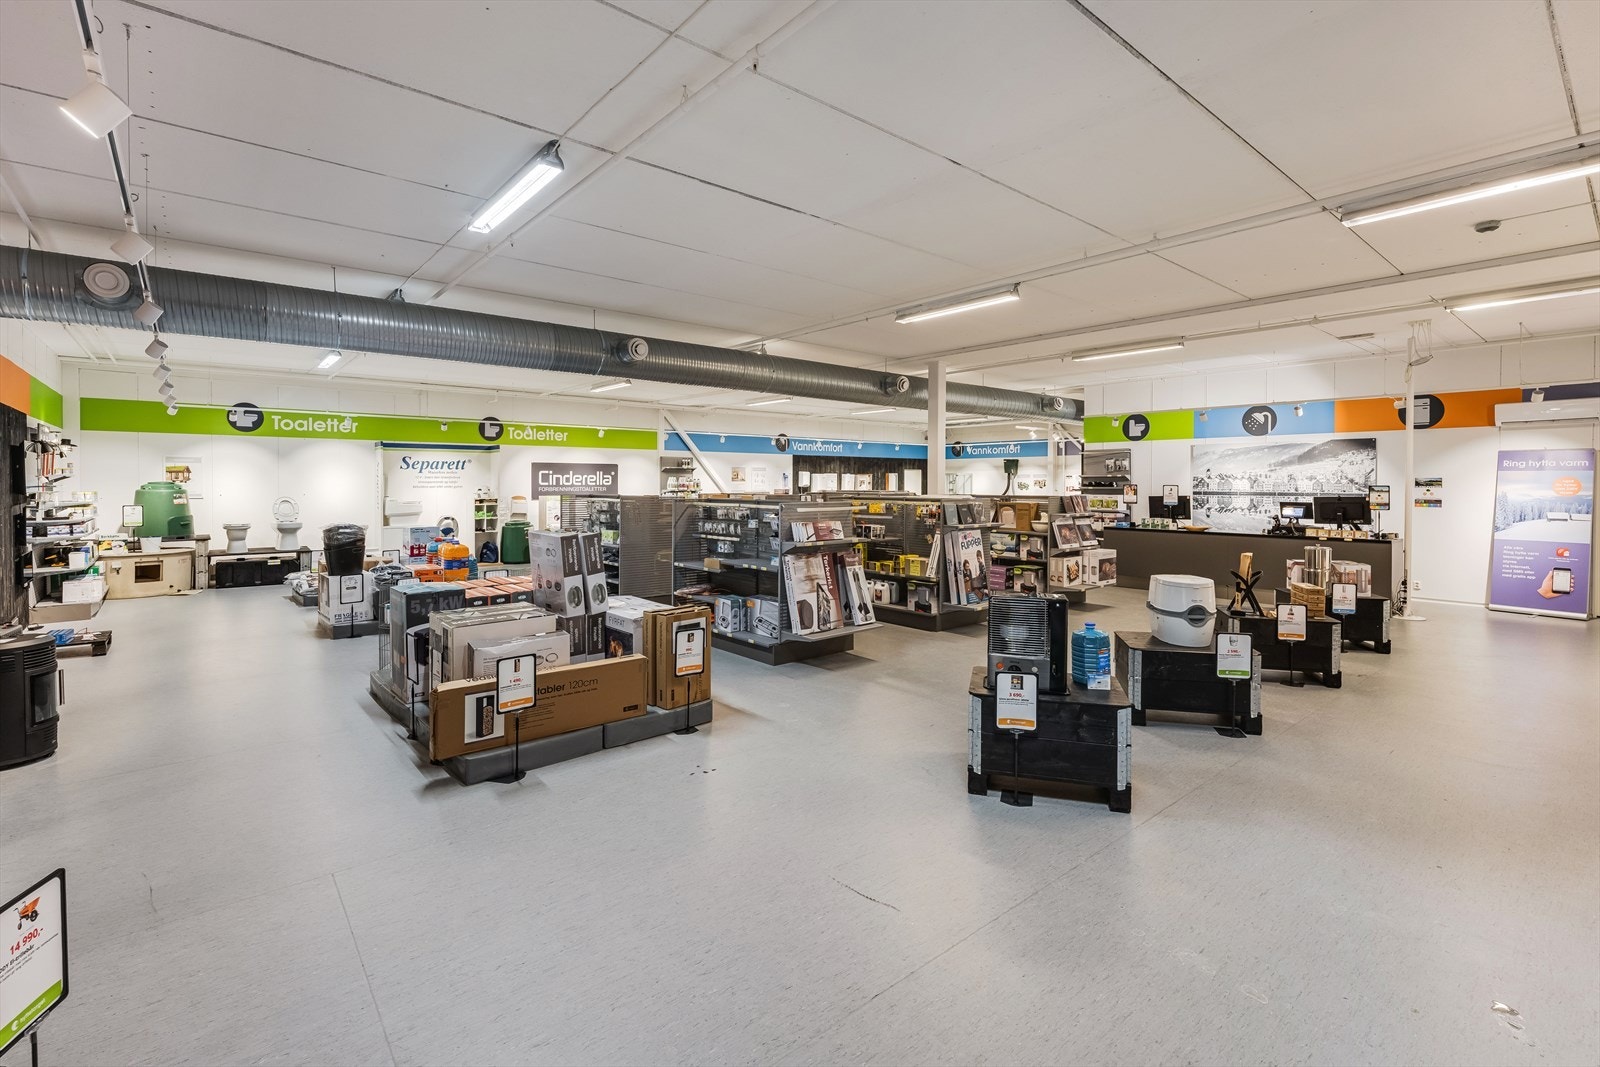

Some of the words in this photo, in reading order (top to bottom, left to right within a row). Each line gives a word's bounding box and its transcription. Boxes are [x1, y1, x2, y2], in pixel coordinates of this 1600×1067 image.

[272, 415, 358, 433] Toaletter
[508, 426, 568, 442] Toaletter
[792, 440, 843, 452] Vannkomfort
[1503, 460, 1526, 468] Ring
[1528, 460, 1556, 468] hytta
[538, 470, 612, 486] Cinderella
[440, 595, 464, 610] kW
[569, 678, 598, 690] 120cm
[10, 941, 20, 955] 14
[22, 928, 44, 946] 990,-
